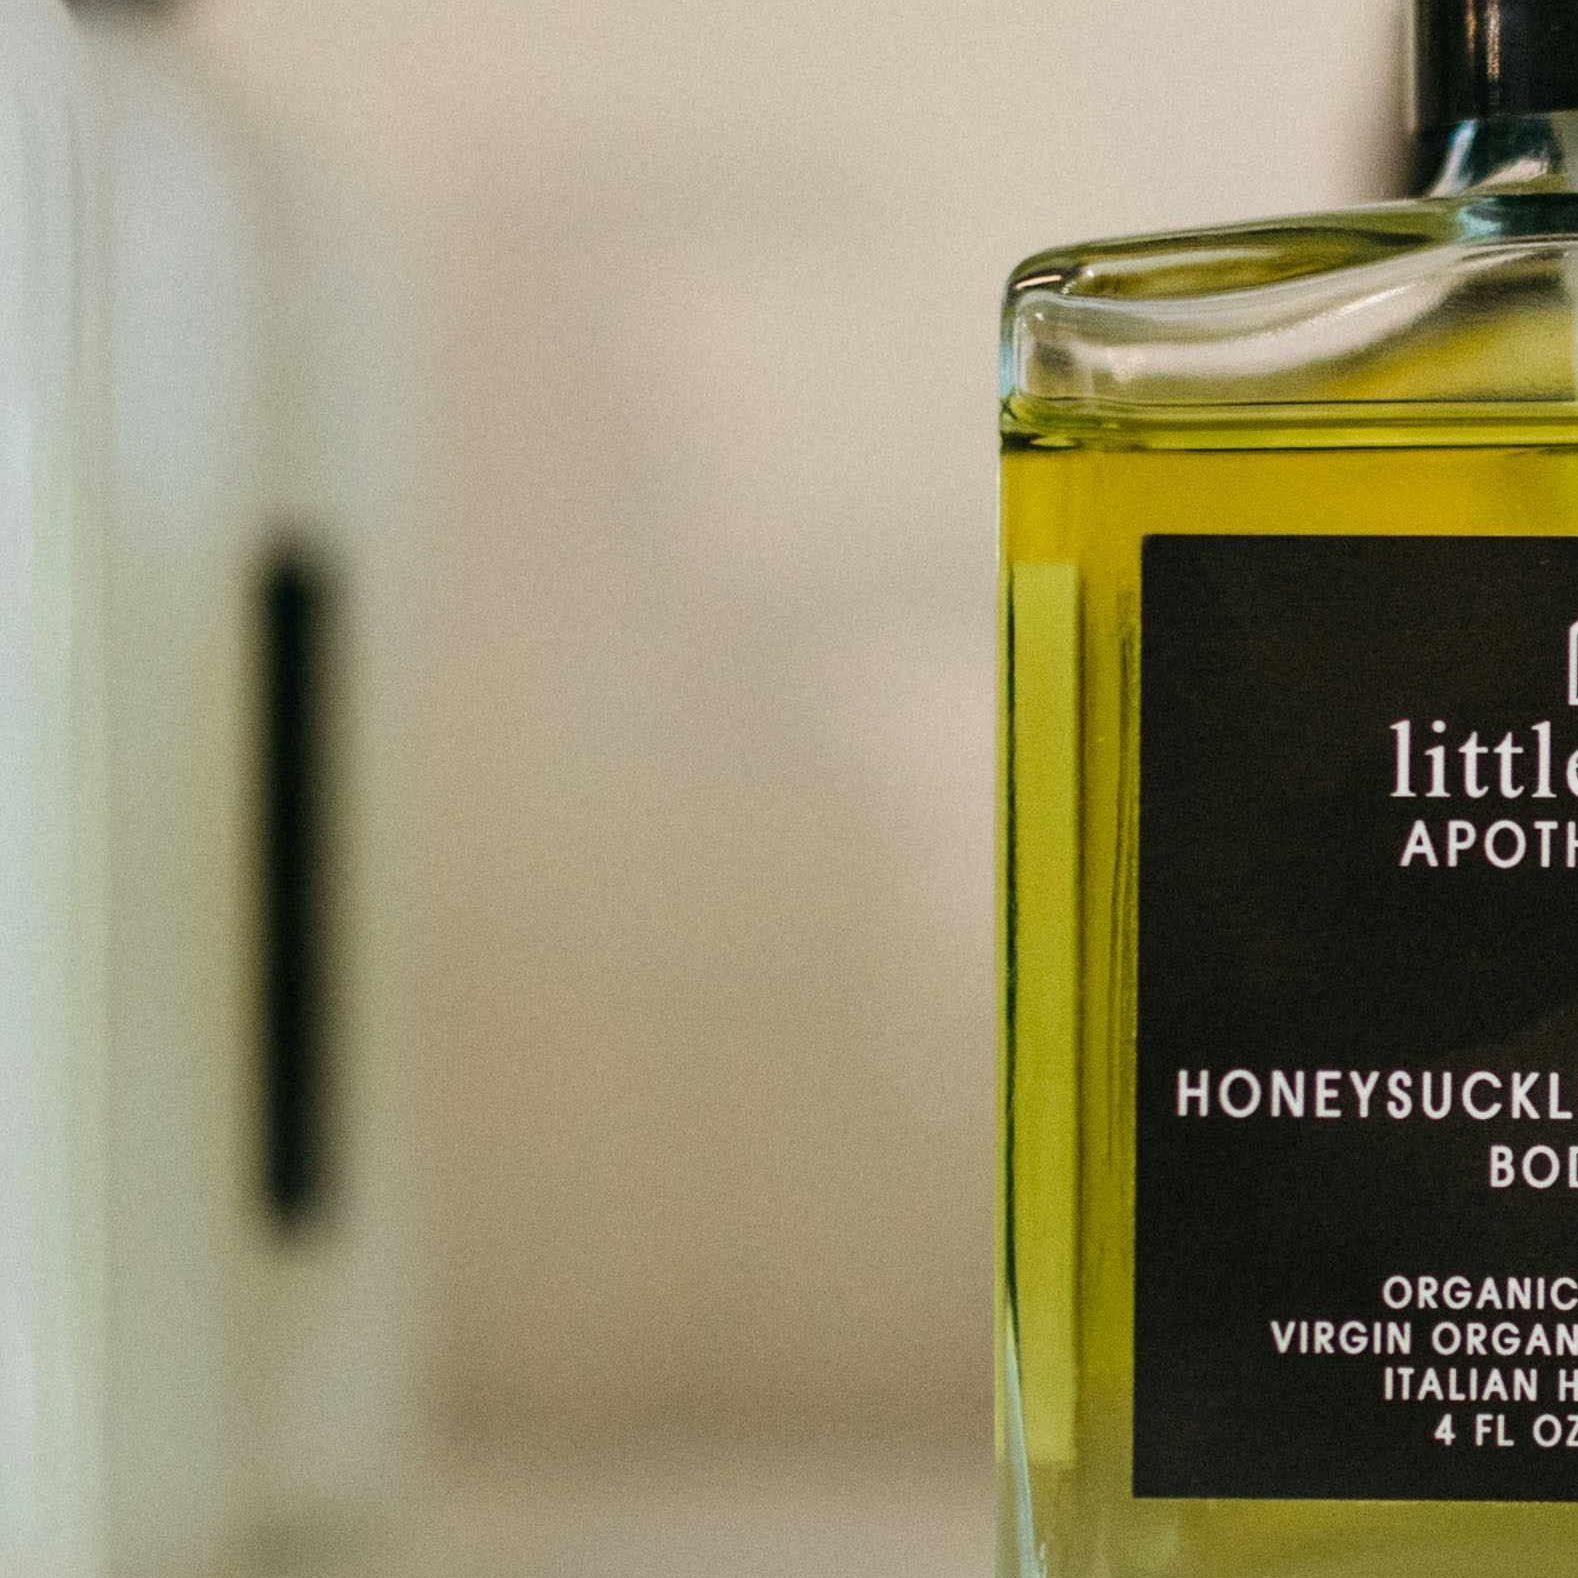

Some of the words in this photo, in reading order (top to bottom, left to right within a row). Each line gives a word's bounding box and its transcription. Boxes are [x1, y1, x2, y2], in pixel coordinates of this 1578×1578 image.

[1382, 1275, 1578, 1311] ORGANIC
[1270, 1320, 1411, 1355] VIRGIN
[1384, 1366, 1538, 1402] ITALIAN
[1434, 1413, 1456, 1446] 4
[1475, 1413, 1515, 1447] FL
